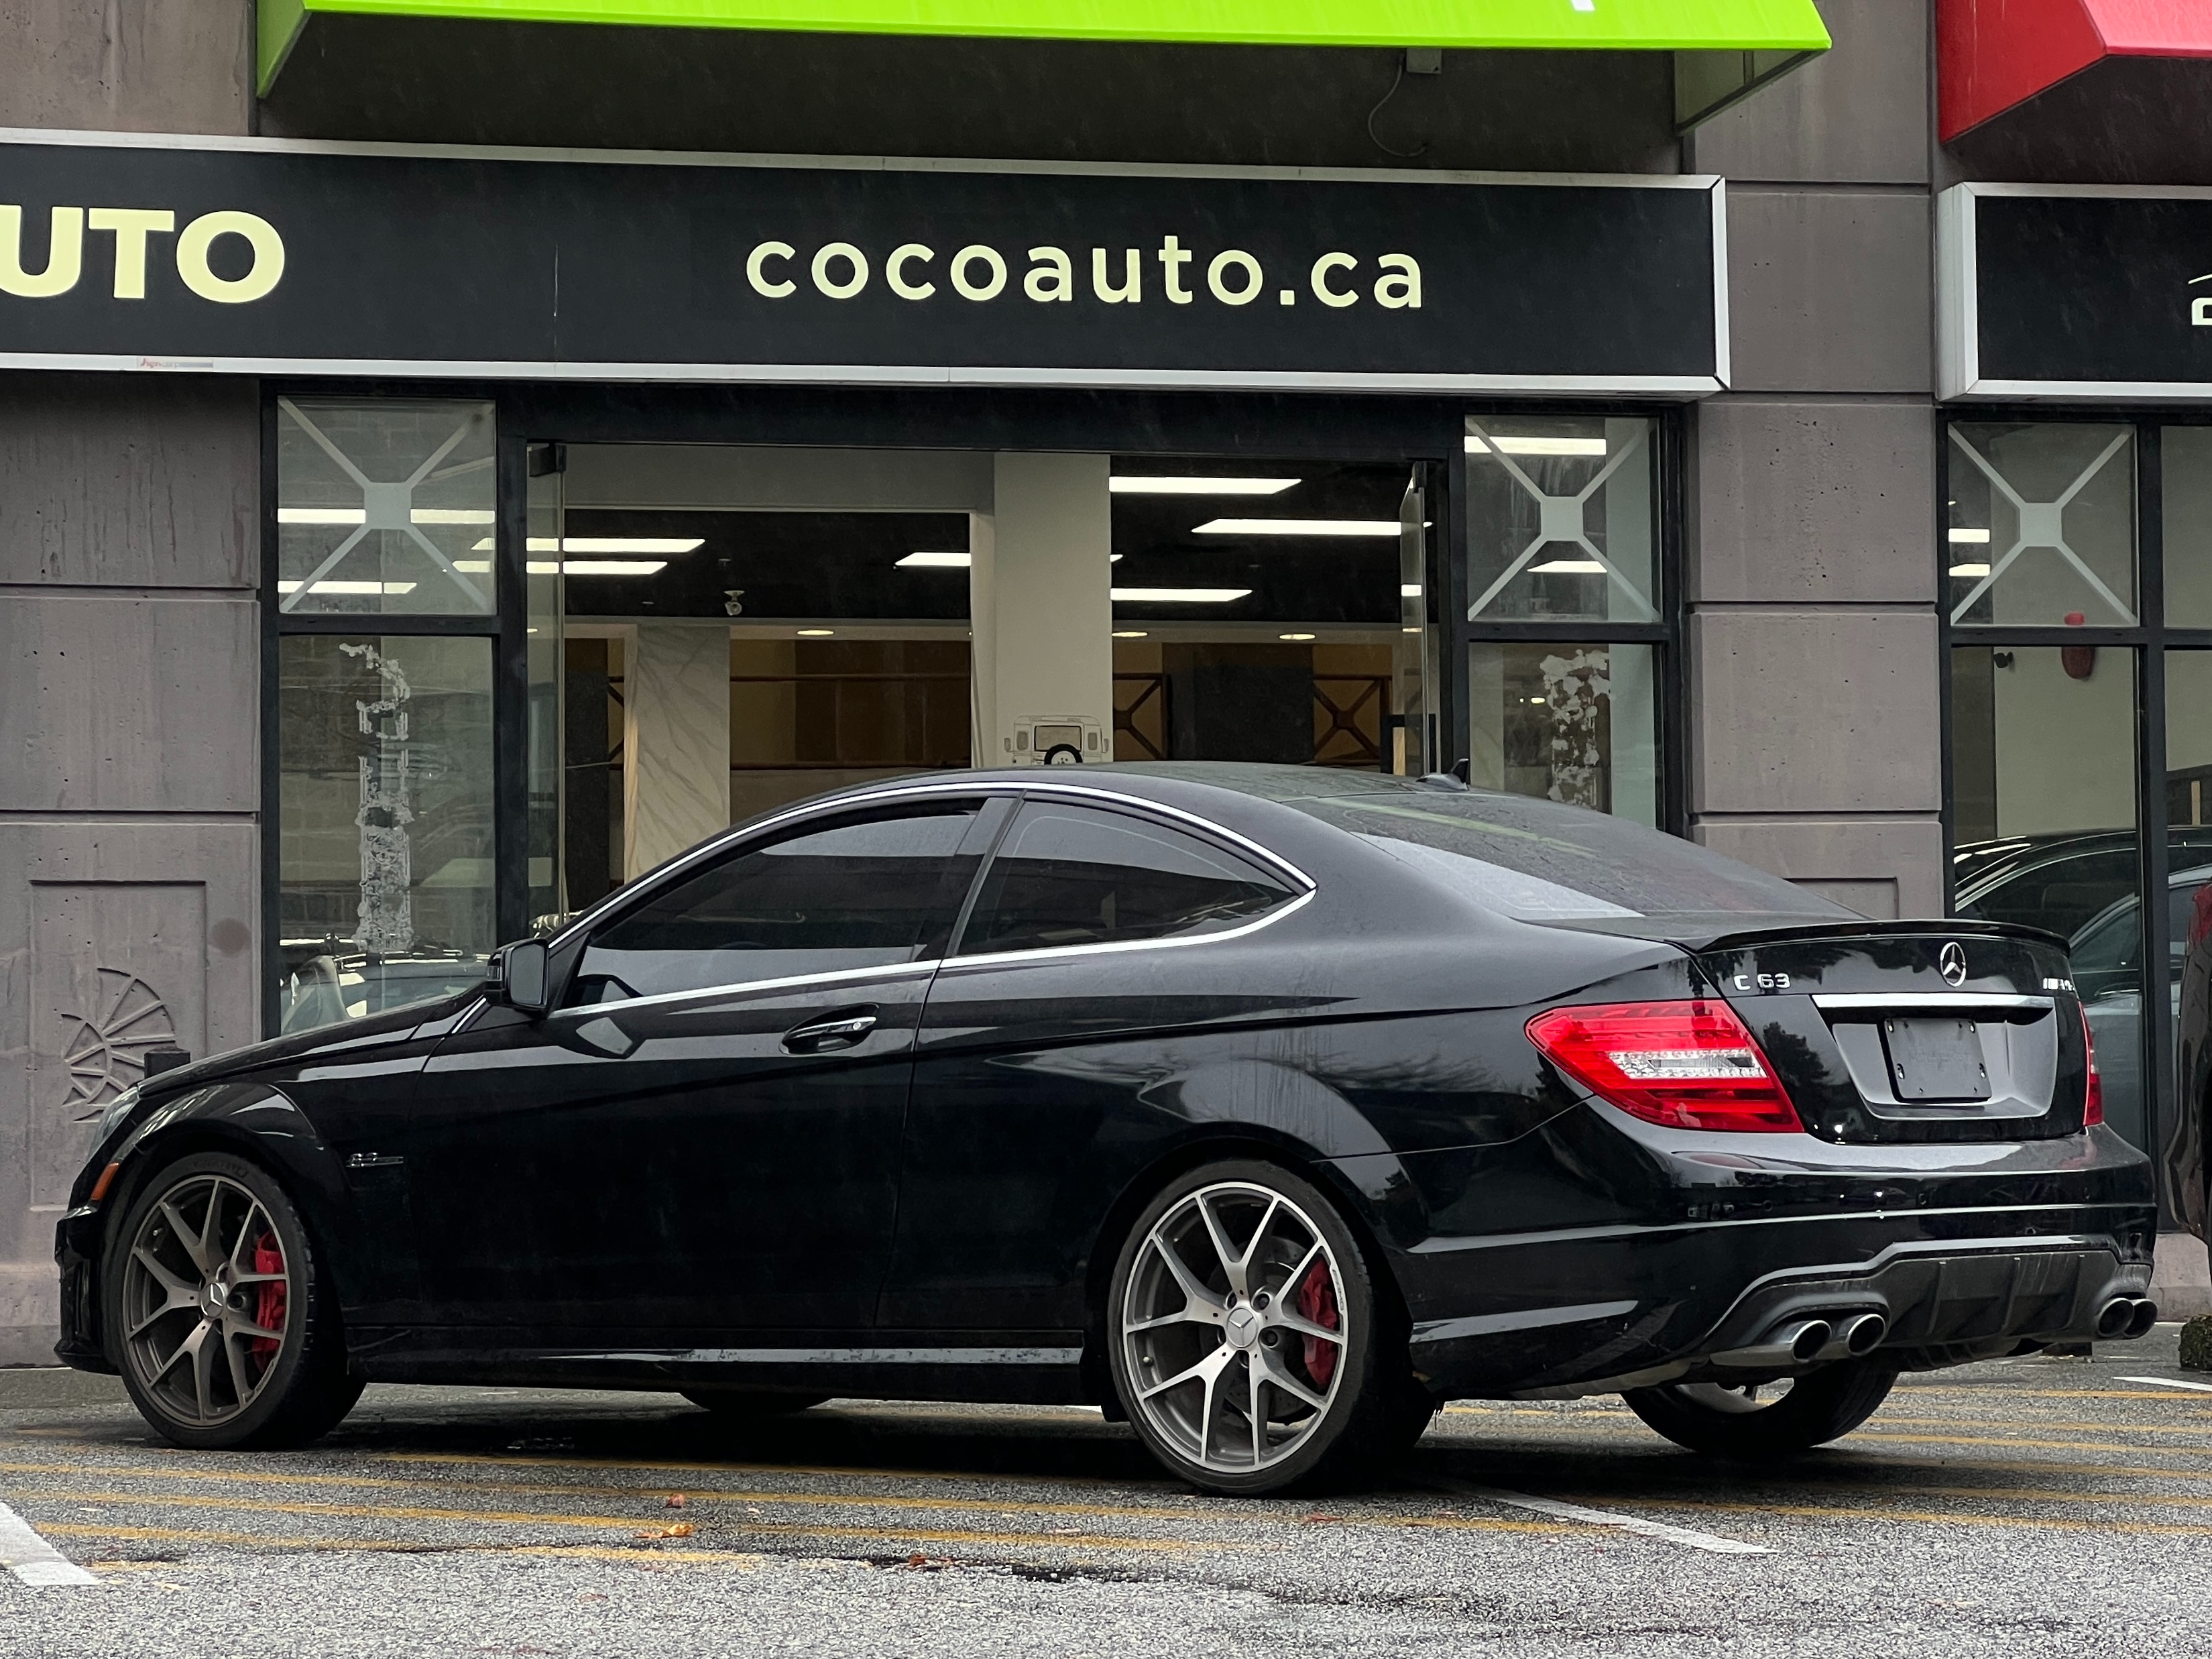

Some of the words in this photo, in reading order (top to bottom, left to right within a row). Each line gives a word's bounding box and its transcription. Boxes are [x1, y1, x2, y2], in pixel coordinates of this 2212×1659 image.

[746, 235, 1421, 308] cocoauto.ca
[1734, 974, 1751, 990] C
[1757, 973, 1790, 988] 63
